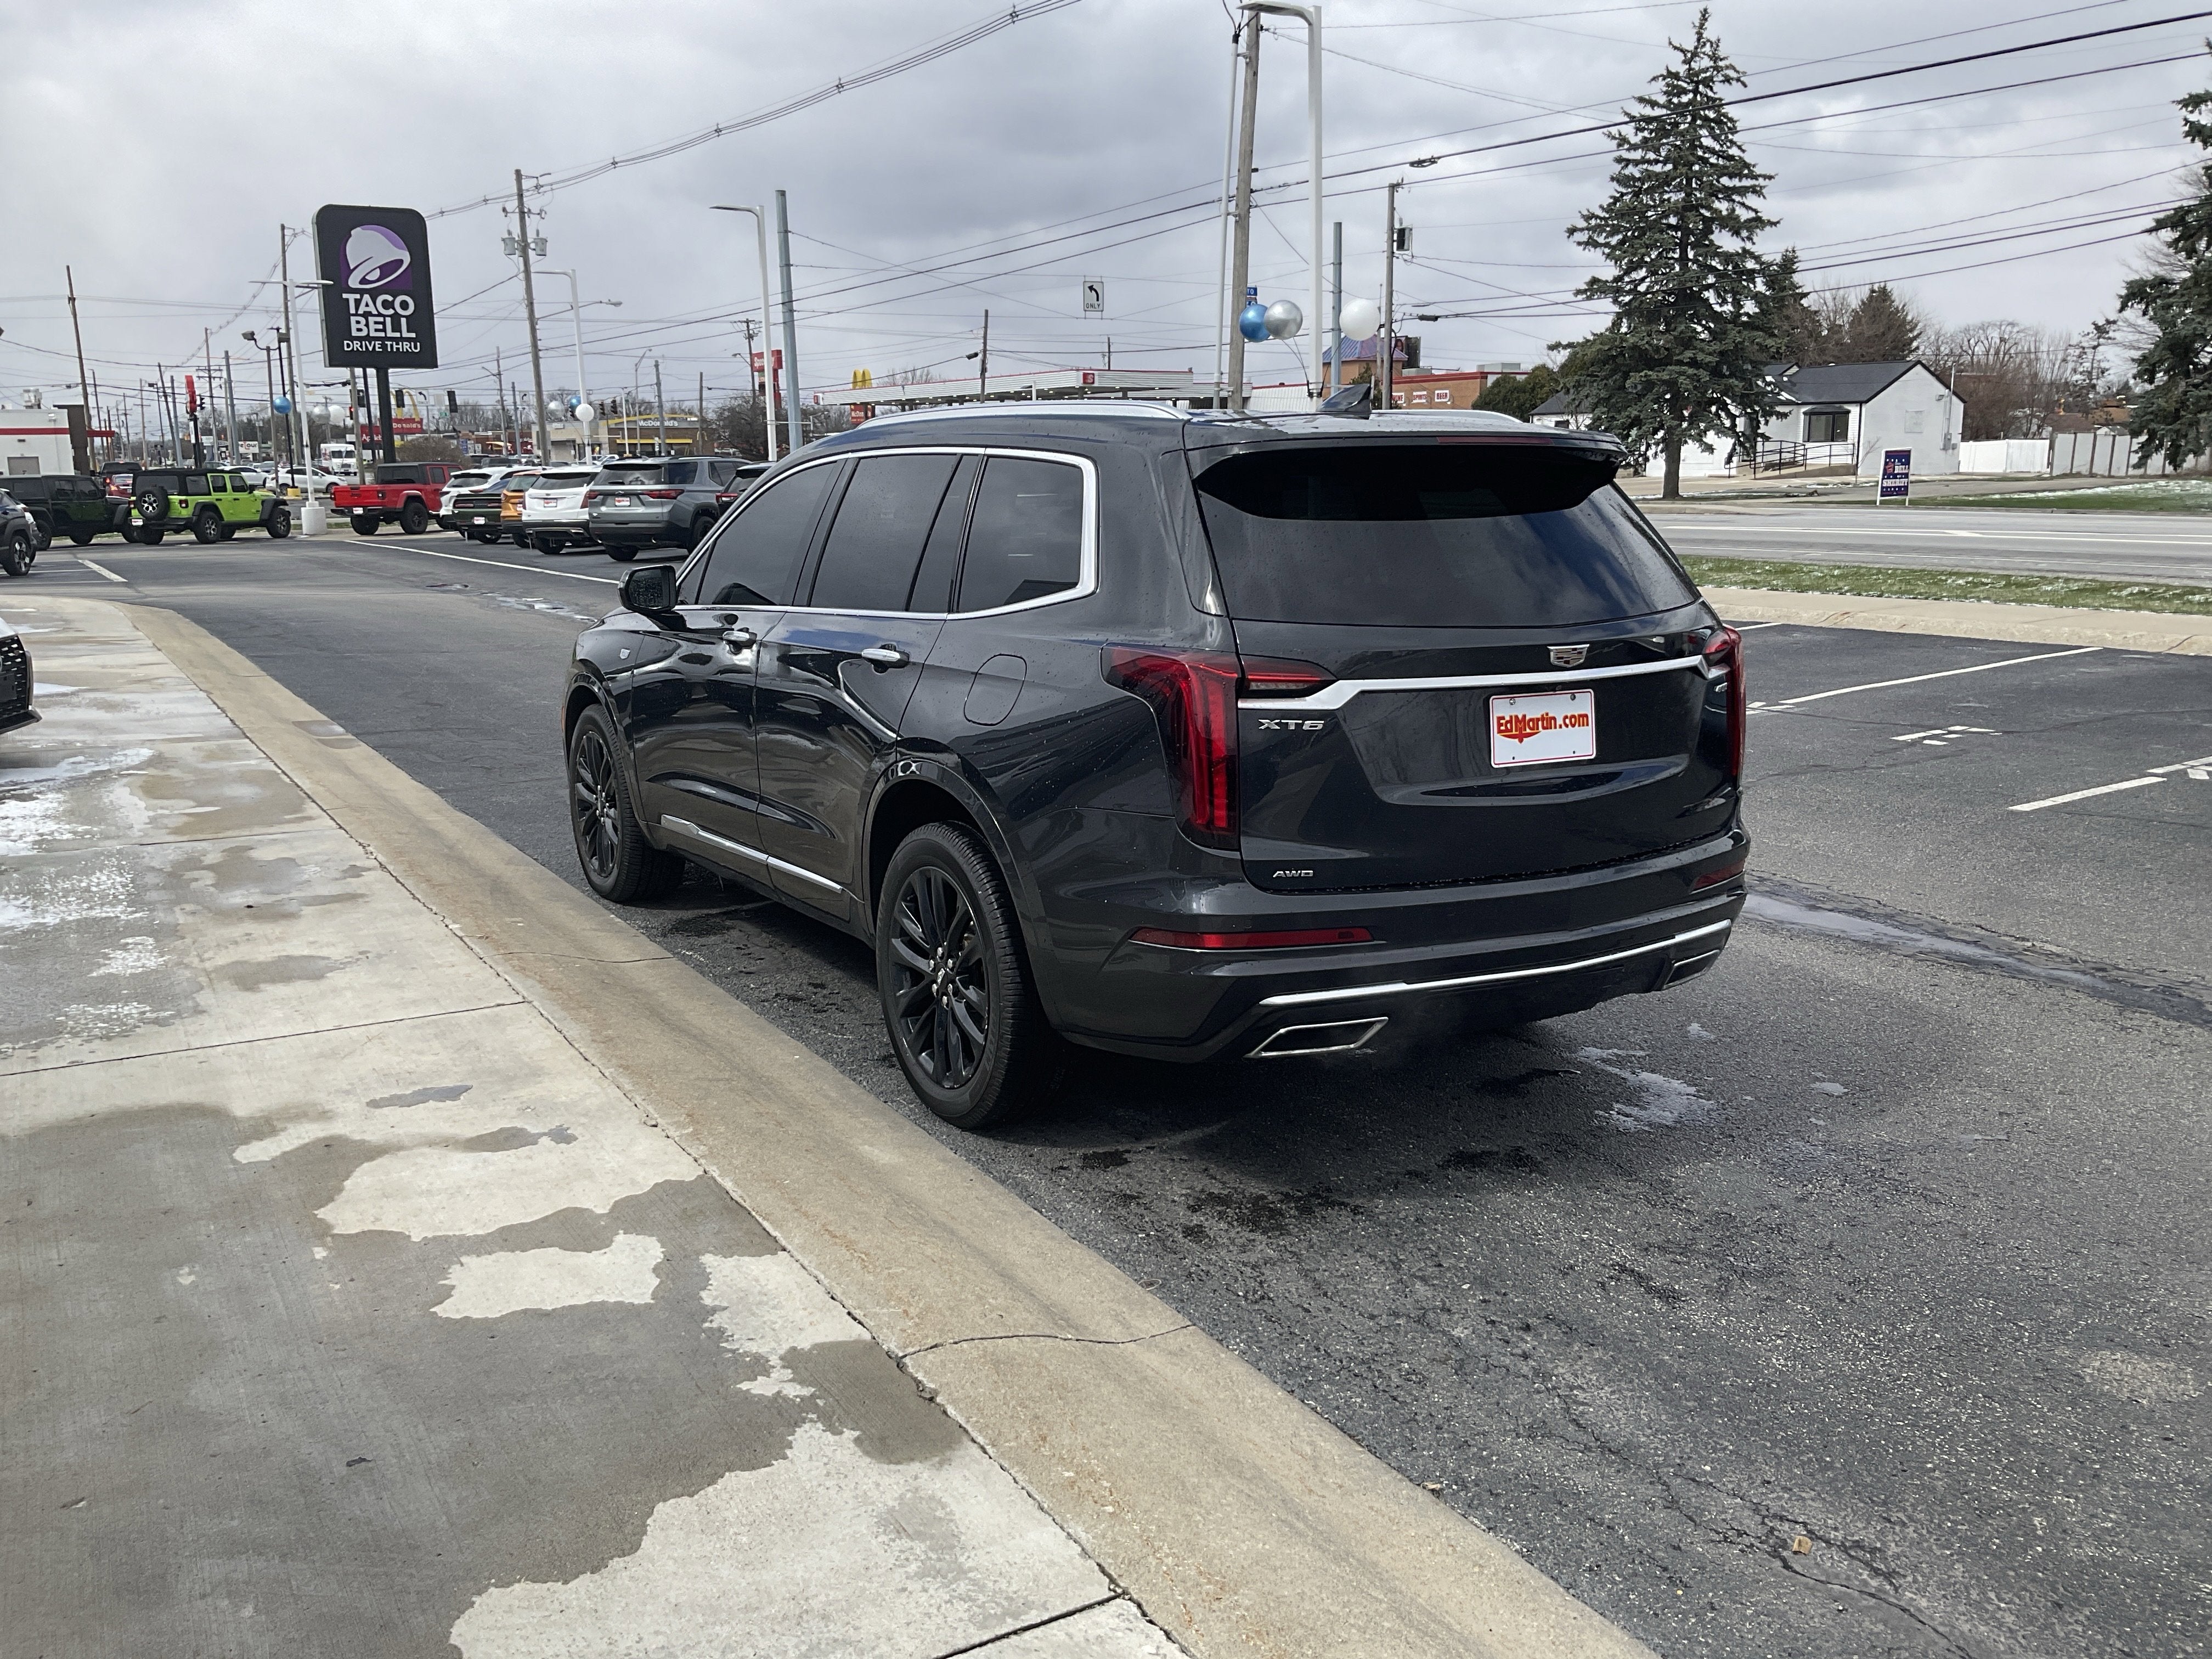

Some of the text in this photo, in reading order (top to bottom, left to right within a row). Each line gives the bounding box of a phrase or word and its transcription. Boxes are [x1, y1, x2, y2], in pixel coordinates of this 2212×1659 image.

[342, 293, 415, 316] TACO
[350, 315, 416, 338] BELL
[343, 340, 420, 352] DRIVE THRU
[1258, 719, 1324, 730] XT6
[1496, 712, 1589, 735] EdMartin.com
